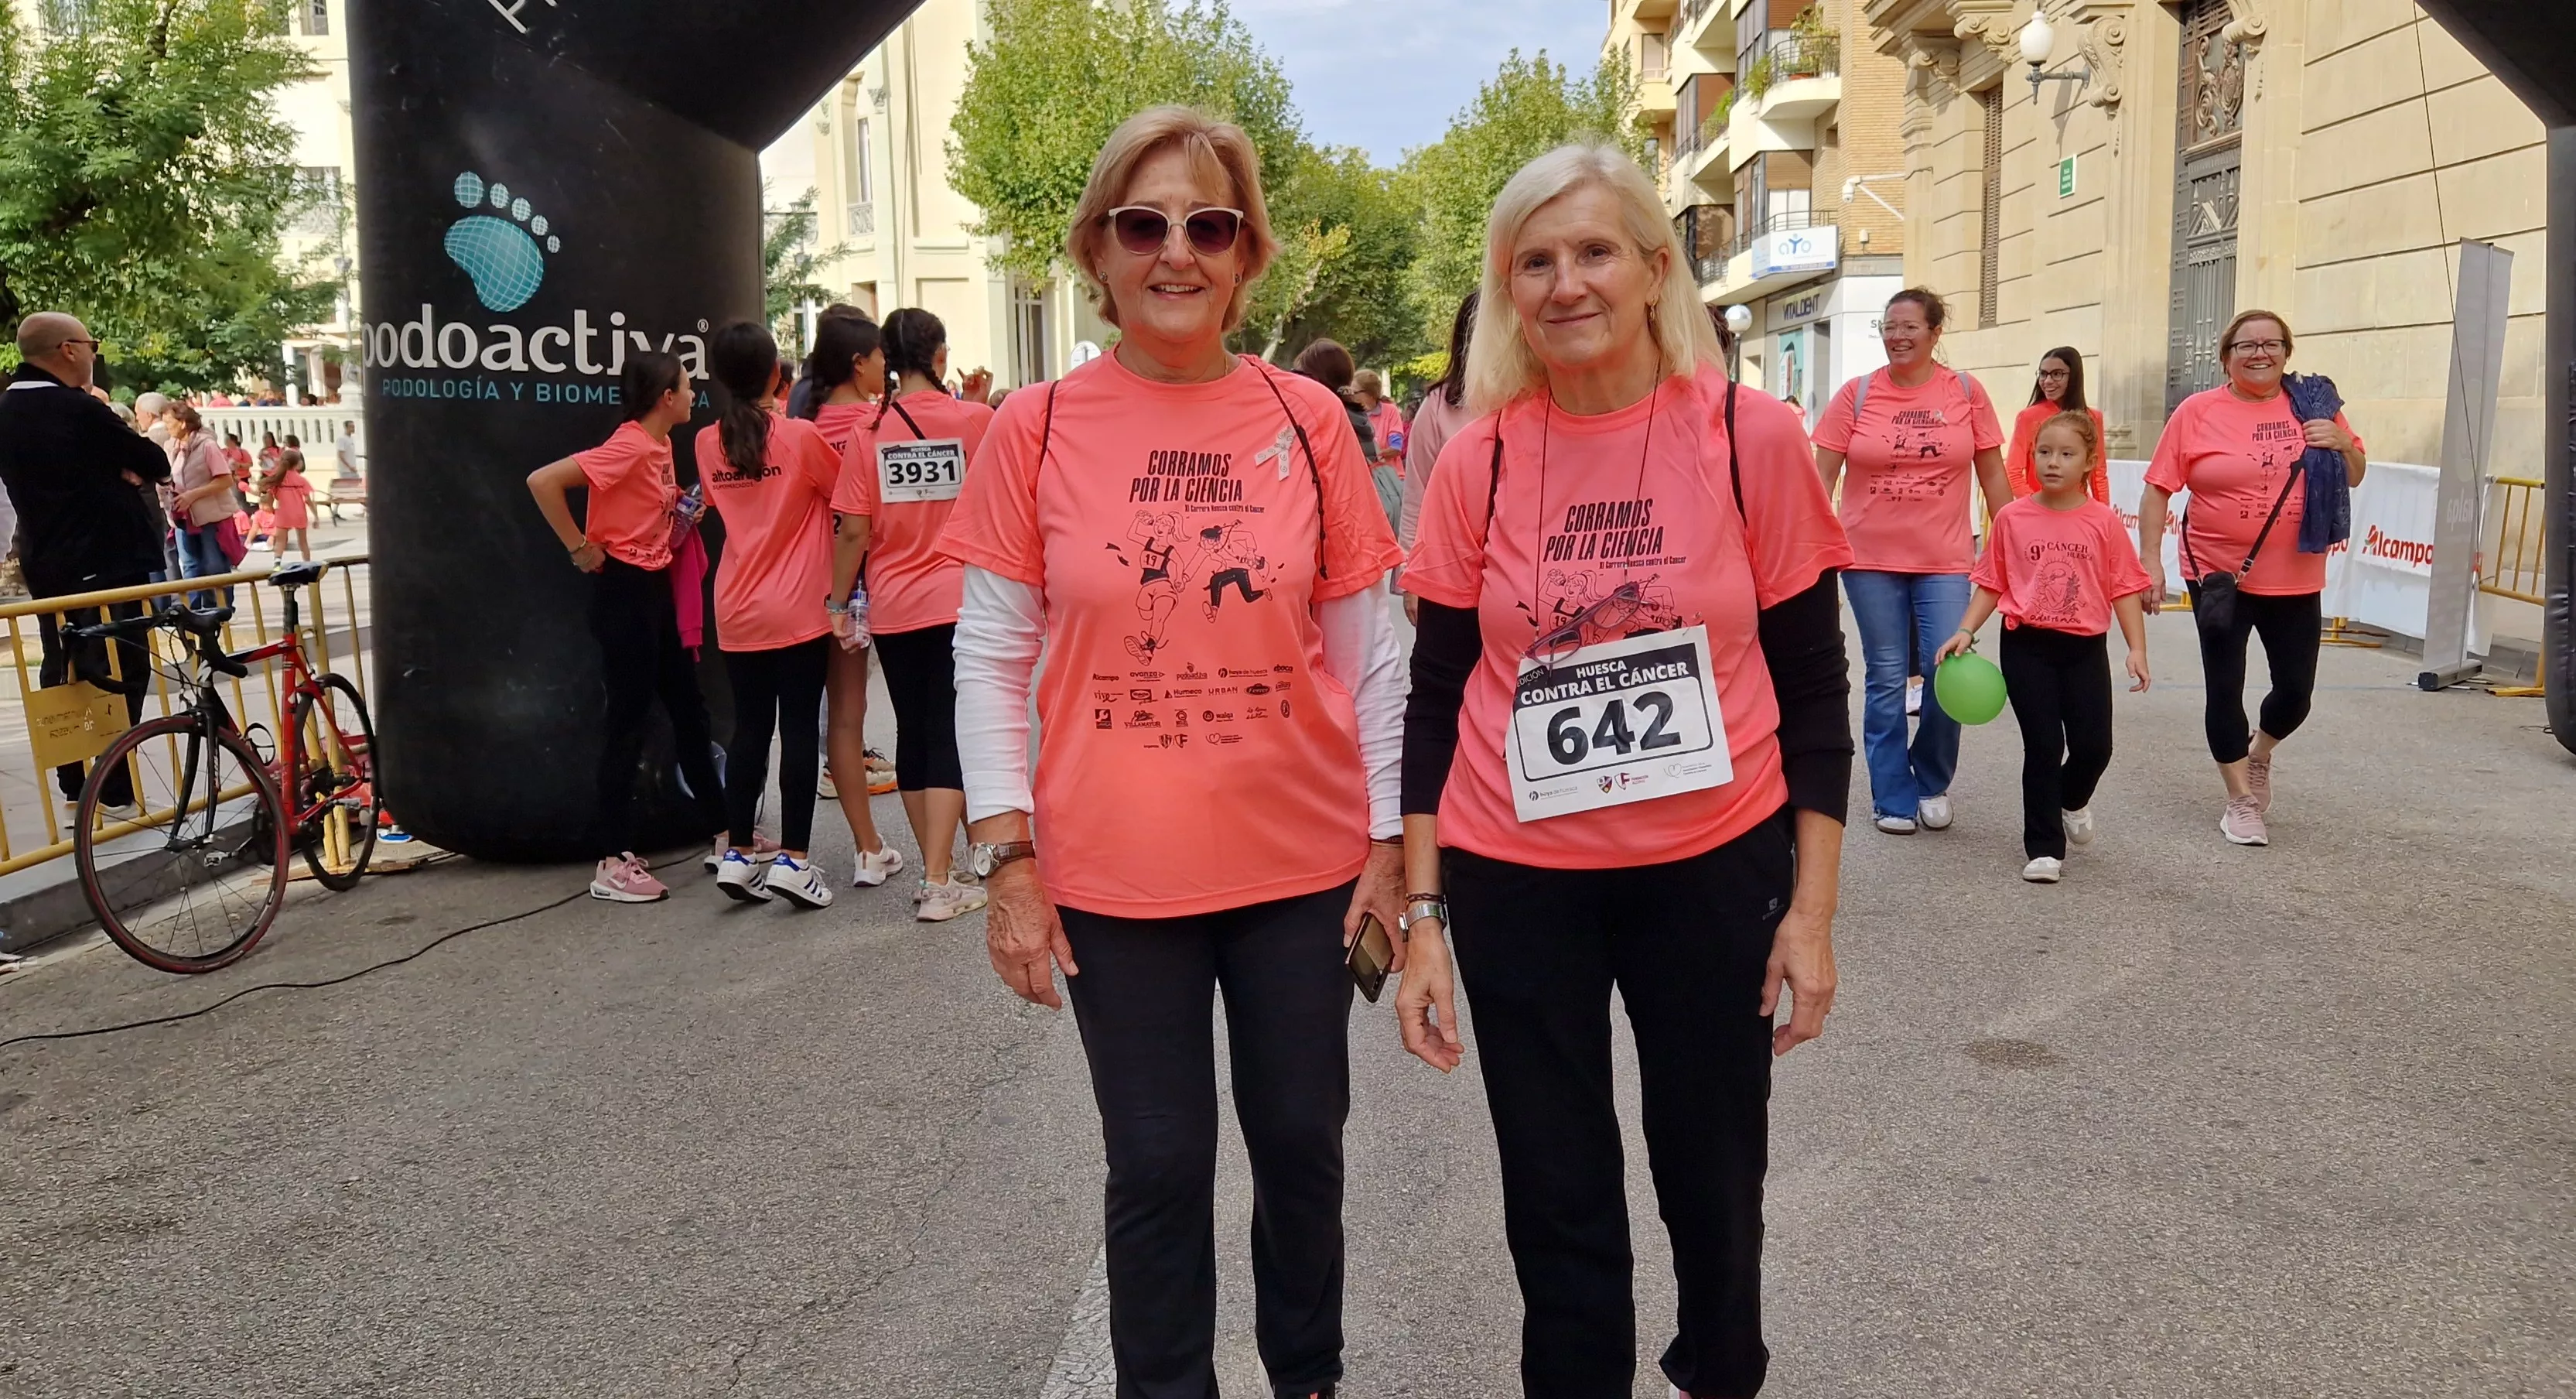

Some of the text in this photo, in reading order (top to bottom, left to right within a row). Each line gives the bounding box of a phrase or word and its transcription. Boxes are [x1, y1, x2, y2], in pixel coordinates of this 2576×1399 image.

[1783, 293, 1820, 320] VITALDENT
[382, 375, 501, 400] PODOLOGÍA
[510, 382, 524, 401] Y
[888, 460, 956, 484] 3931
[1147, 450, 1232, 477] CORRAMOS
[1129, 477, 1242, 503] POR LA CIENCIA
[1563, 498, 1653, 533] CORRAMOS
[1543, 526, 1664, 562] POR LA CIENCIA
[2047, 542, 2088, 553] CÁNCER
[2362, 525, 2434, 568] Alcampo
[1146, 553, 1158, 567] 19
[1576, 659, 1627, 679] HUESCA
[1174, 688, 1202, 696] Humeco
[1208, 686, 1238, 696] URBAN
[1520, 661, 1689, 706] CONTRA EL CÁNCER
[1546, 691, 1682, 765] 642
